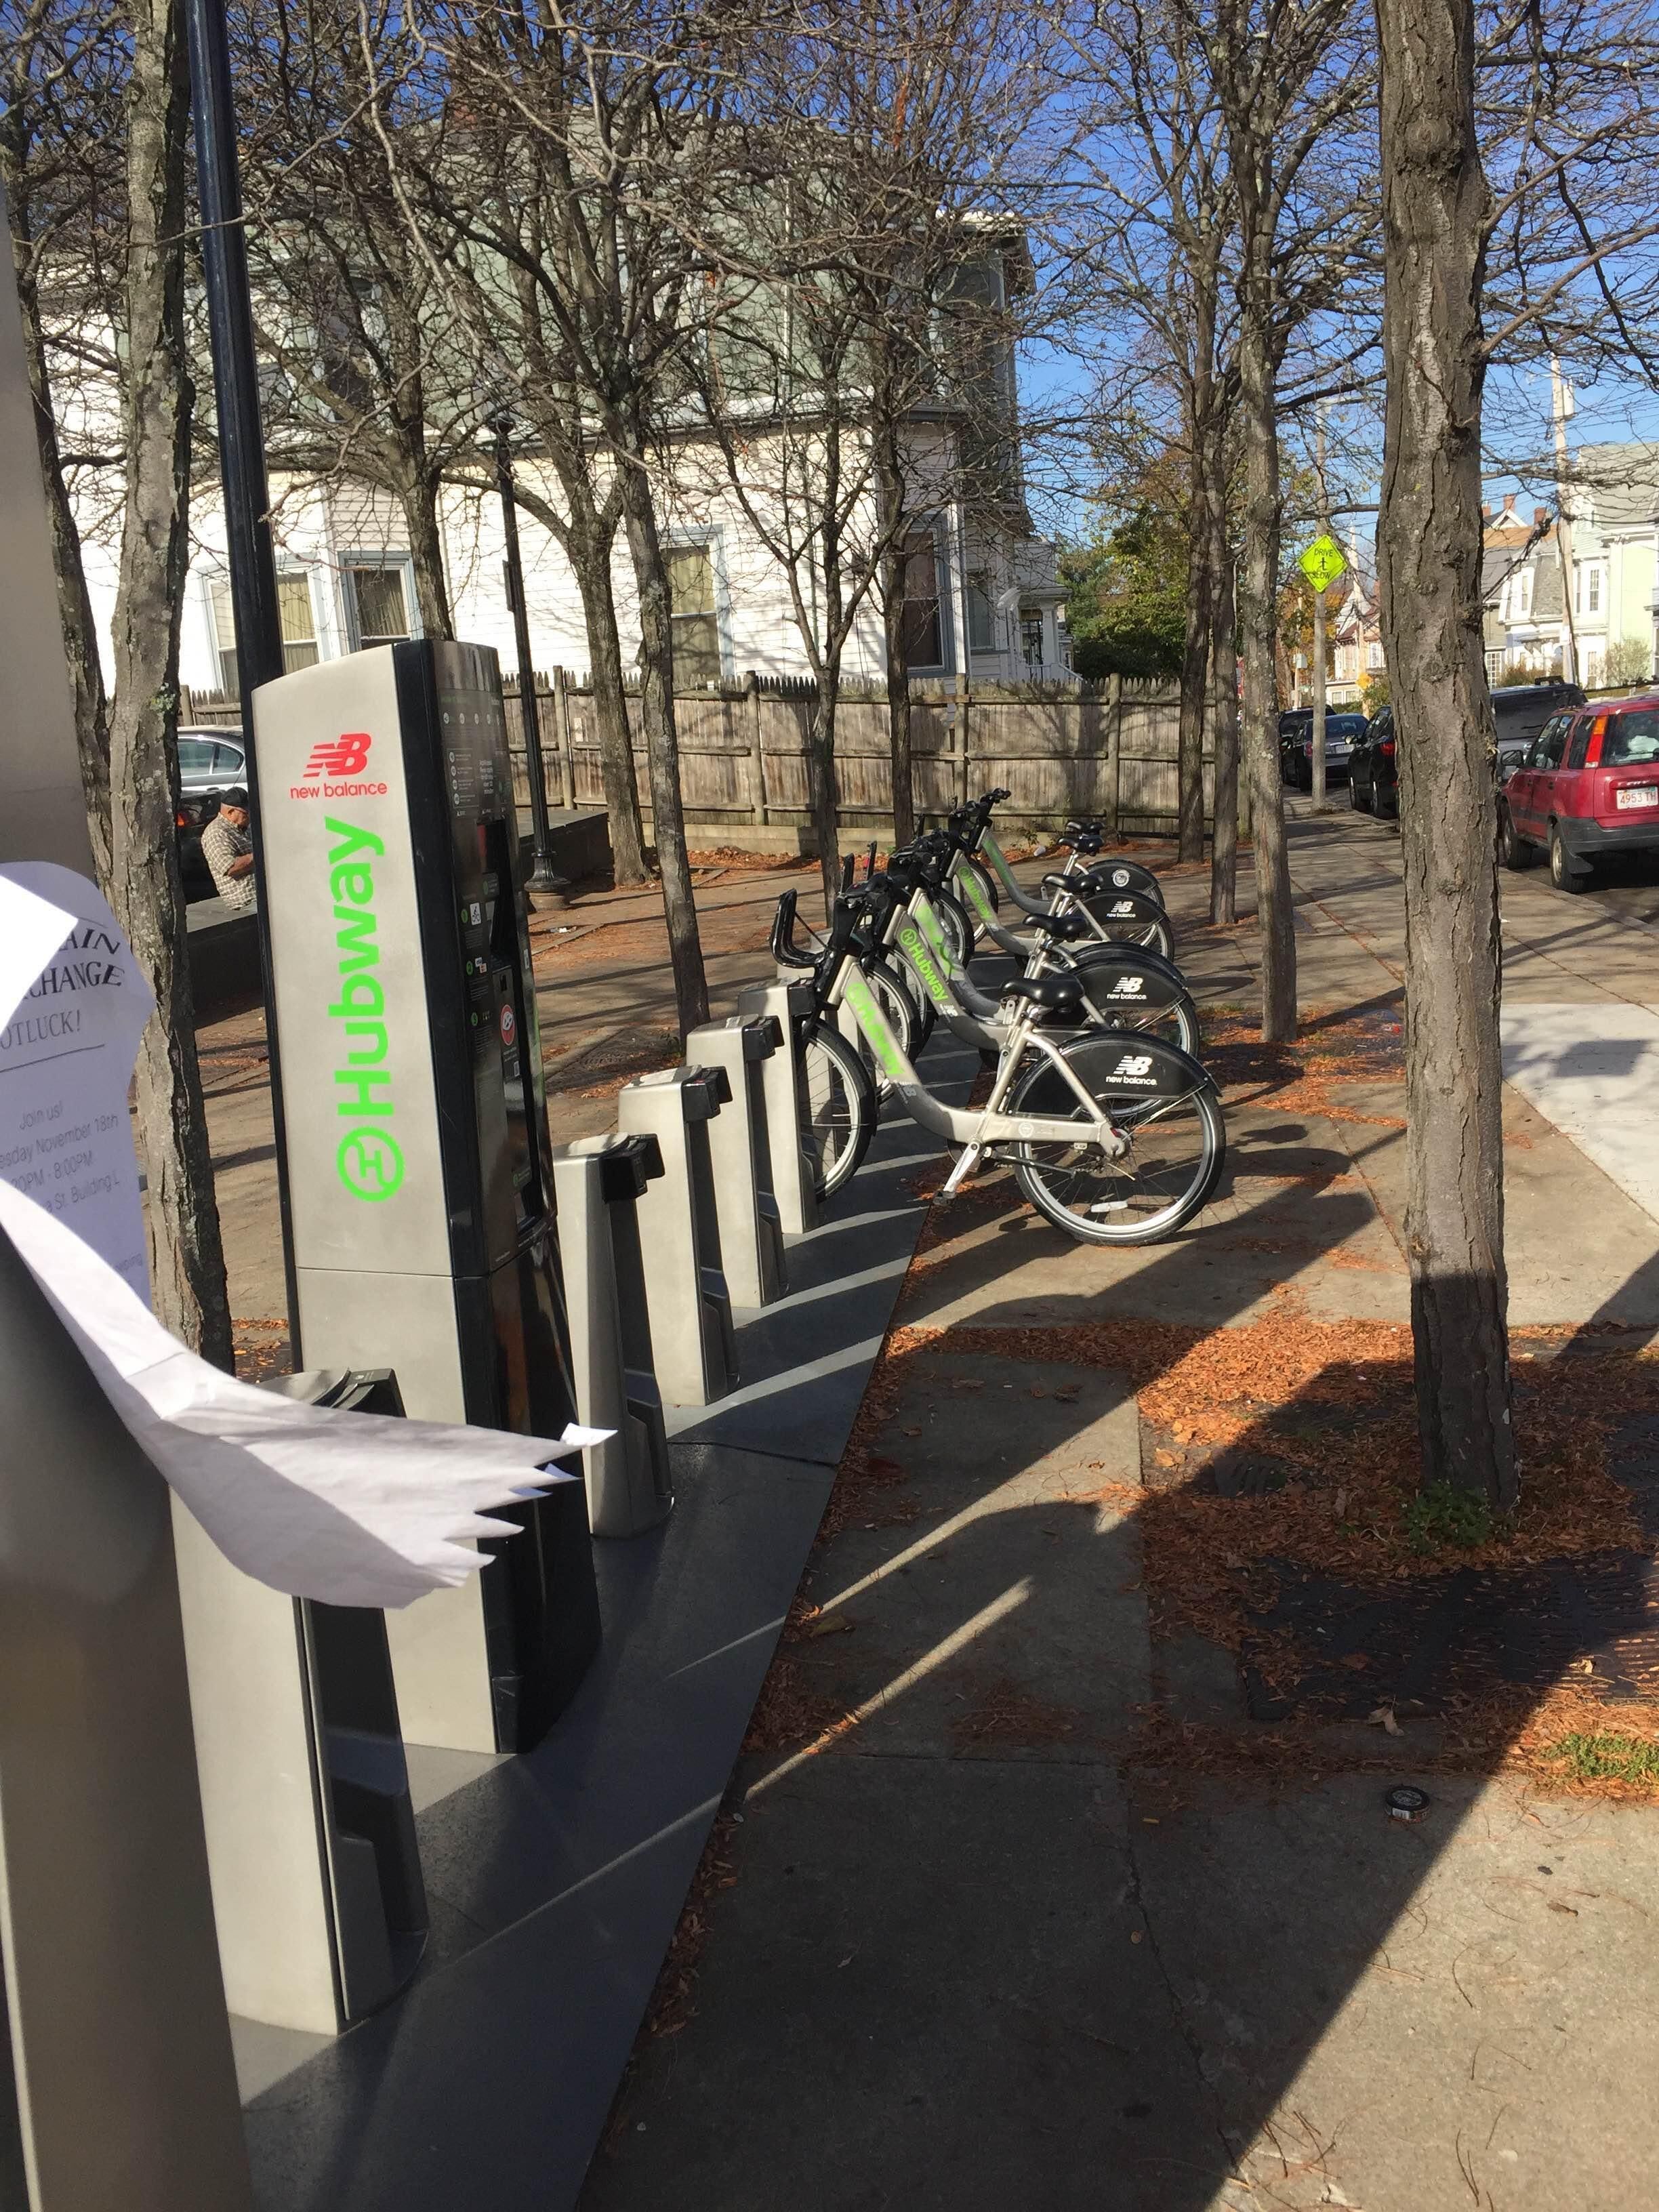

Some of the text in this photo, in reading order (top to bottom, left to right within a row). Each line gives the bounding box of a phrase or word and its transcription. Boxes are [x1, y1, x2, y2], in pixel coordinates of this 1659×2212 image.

[1314, 548, 1334, 557] DRIVE
[290, 783, 388, 799] new balance
[59, 928, 121, 955] AIN
[325, 816, 394, 1117] Hubway
[908, 943, 948, 1001] Hubway
[1123, 1076, 1158, 1086] balance
[19, 1101, 64, 1130] Join us!
[36, 1124, 91, 1153] November
[94, 1115, 119, 1135] 18th
[70, 1173, 112, 1204] Building
